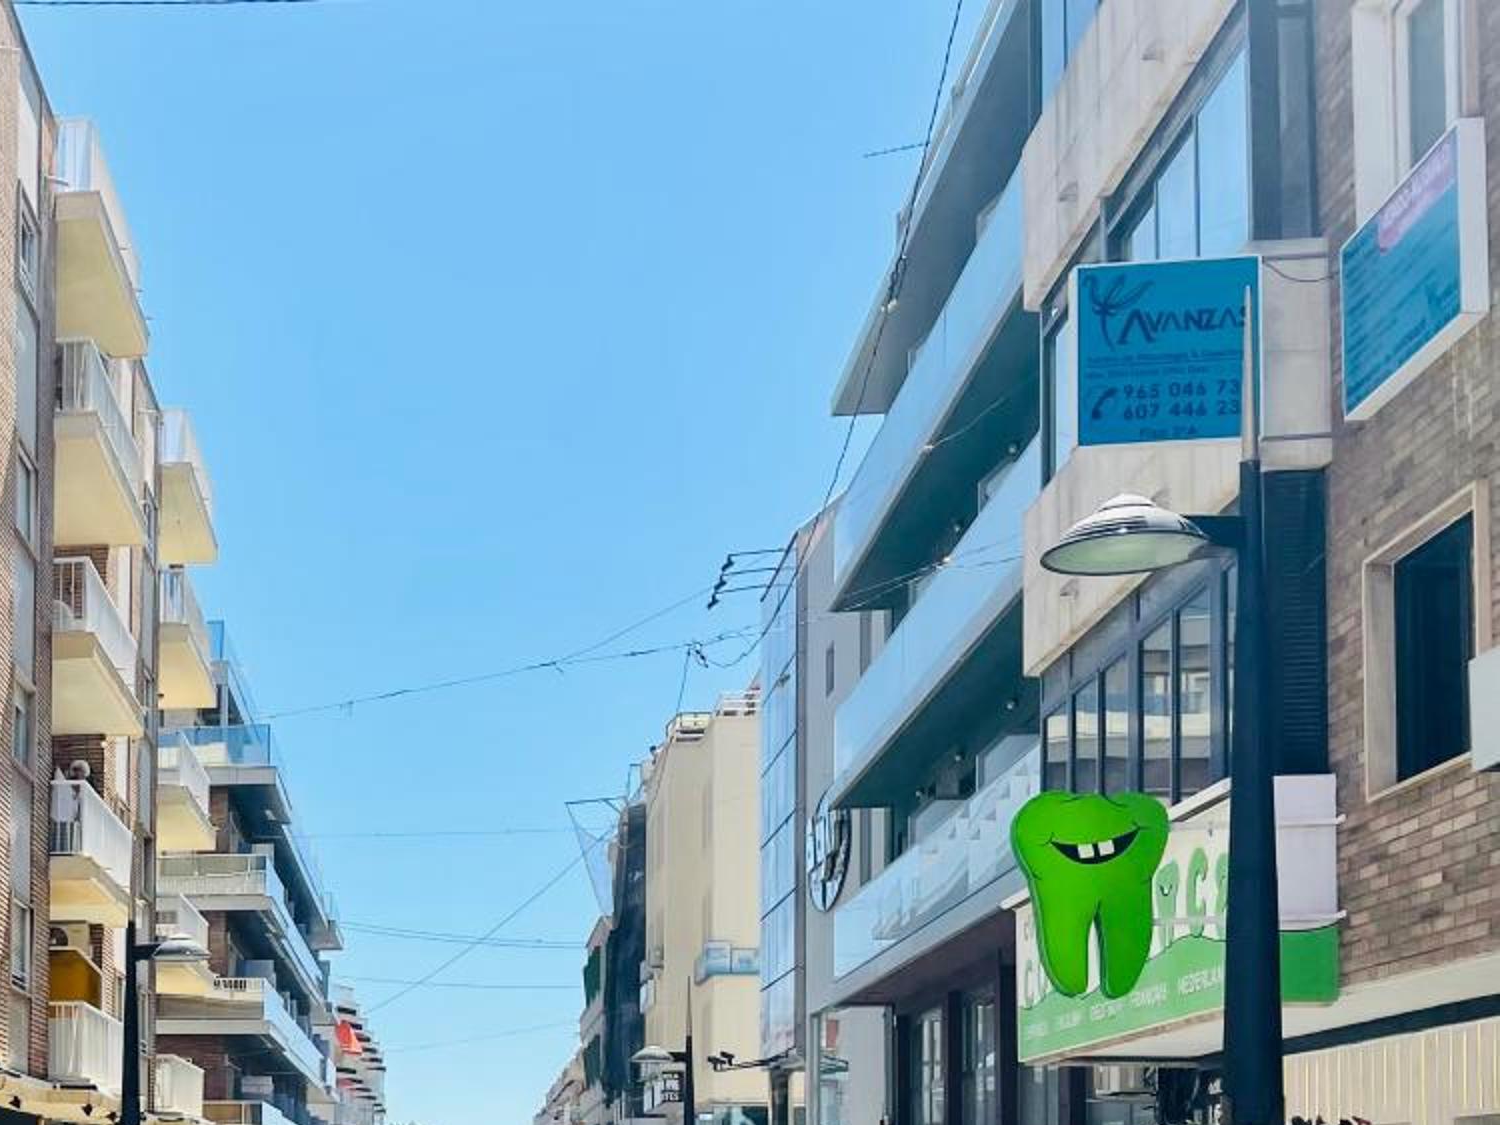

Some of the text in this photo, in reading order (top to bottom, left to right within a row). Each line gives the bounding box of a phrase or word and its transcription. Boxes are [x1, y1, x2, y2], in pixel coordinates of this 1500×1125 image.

[1123, 383, 1160, 399] 965
[1216, 378, 1240, 395] 73
[1123, 403, 1160, 420] 607
[1217, 399, 1240, 415] 23
